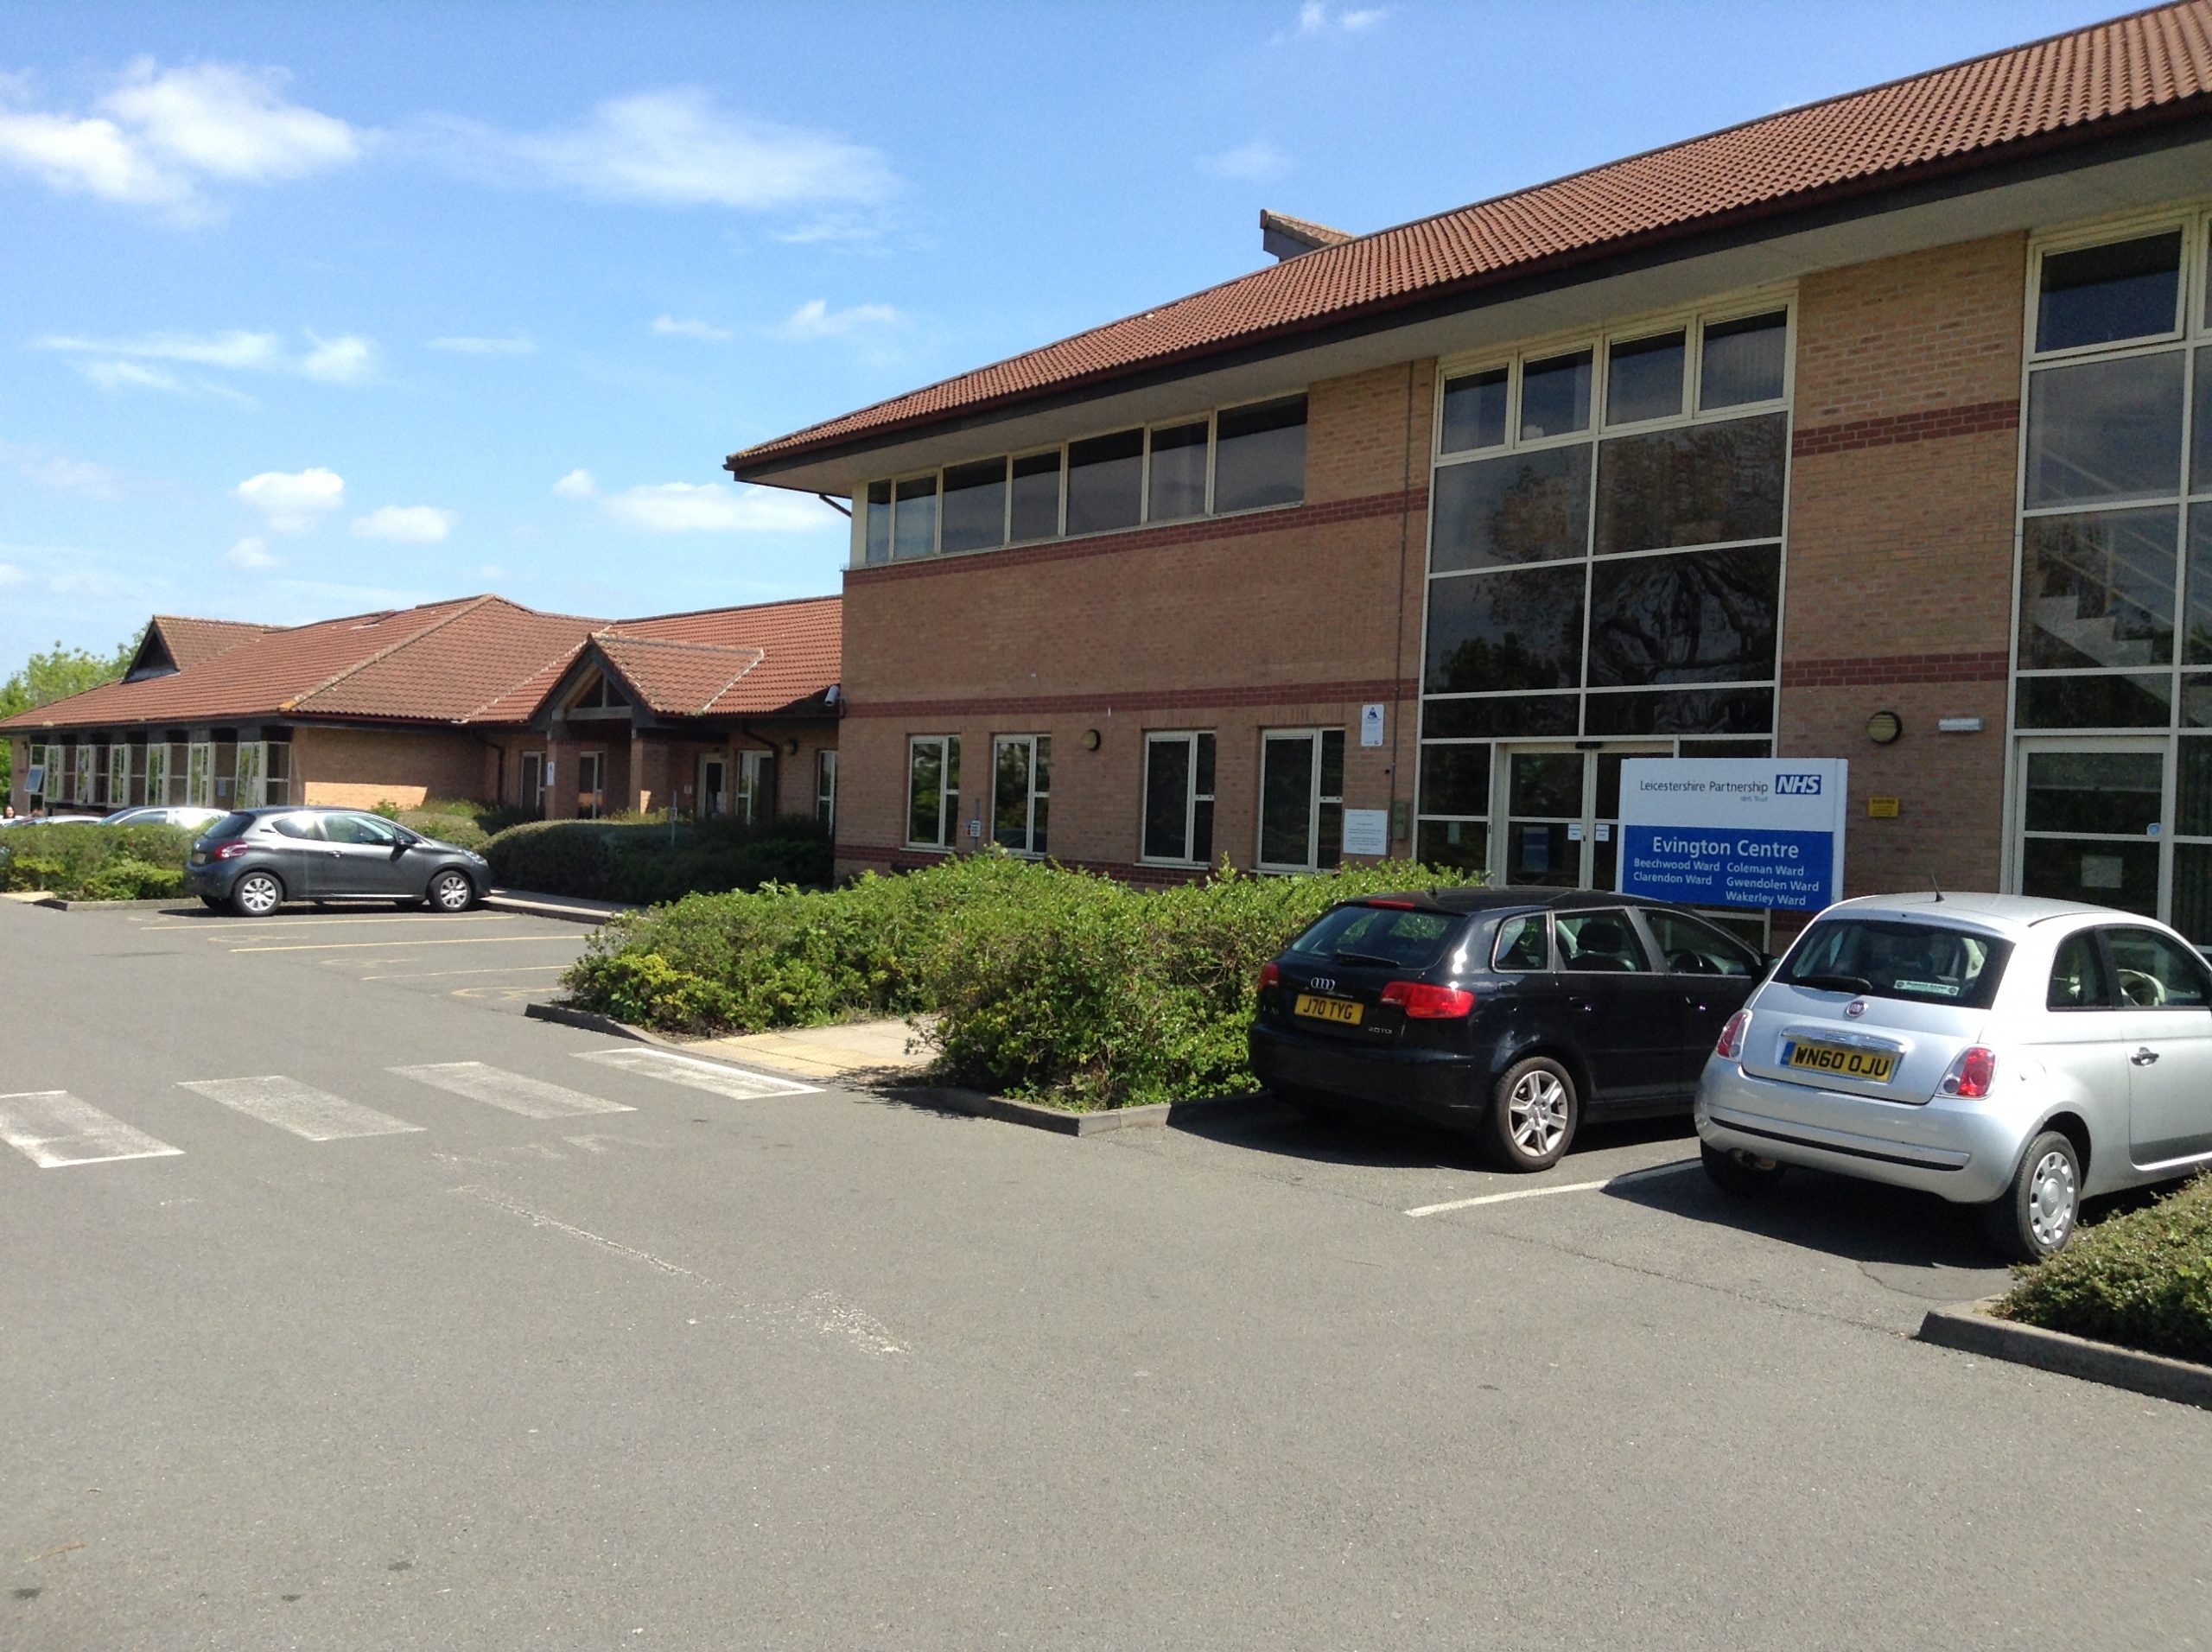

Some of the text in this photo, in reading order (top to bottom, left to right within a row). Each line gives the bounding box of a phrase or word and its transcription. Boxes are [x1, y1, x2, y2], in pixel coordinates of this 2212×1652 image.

[1640, 780, 1769, 794] Leicestershire Partnership
[1776, 775, 1821, 794] NHS
[1653, 836, 1799, 858] Evington Centre
[1634, 858, 1720, 872] Beechwood Ward
[1726, 862, 1804, 876] Coleman Ward
[1633, 872, 1713, 885] Clarendon Ward
[1726, 877, 1820, 892] Gwendolen Ward
[1726, 891, 1807, 908] Wakerley Ward
[1303, 999, 1353, 1020] J70 TYG
[1795, 1046, 1890, 1077] WN60 OJU
